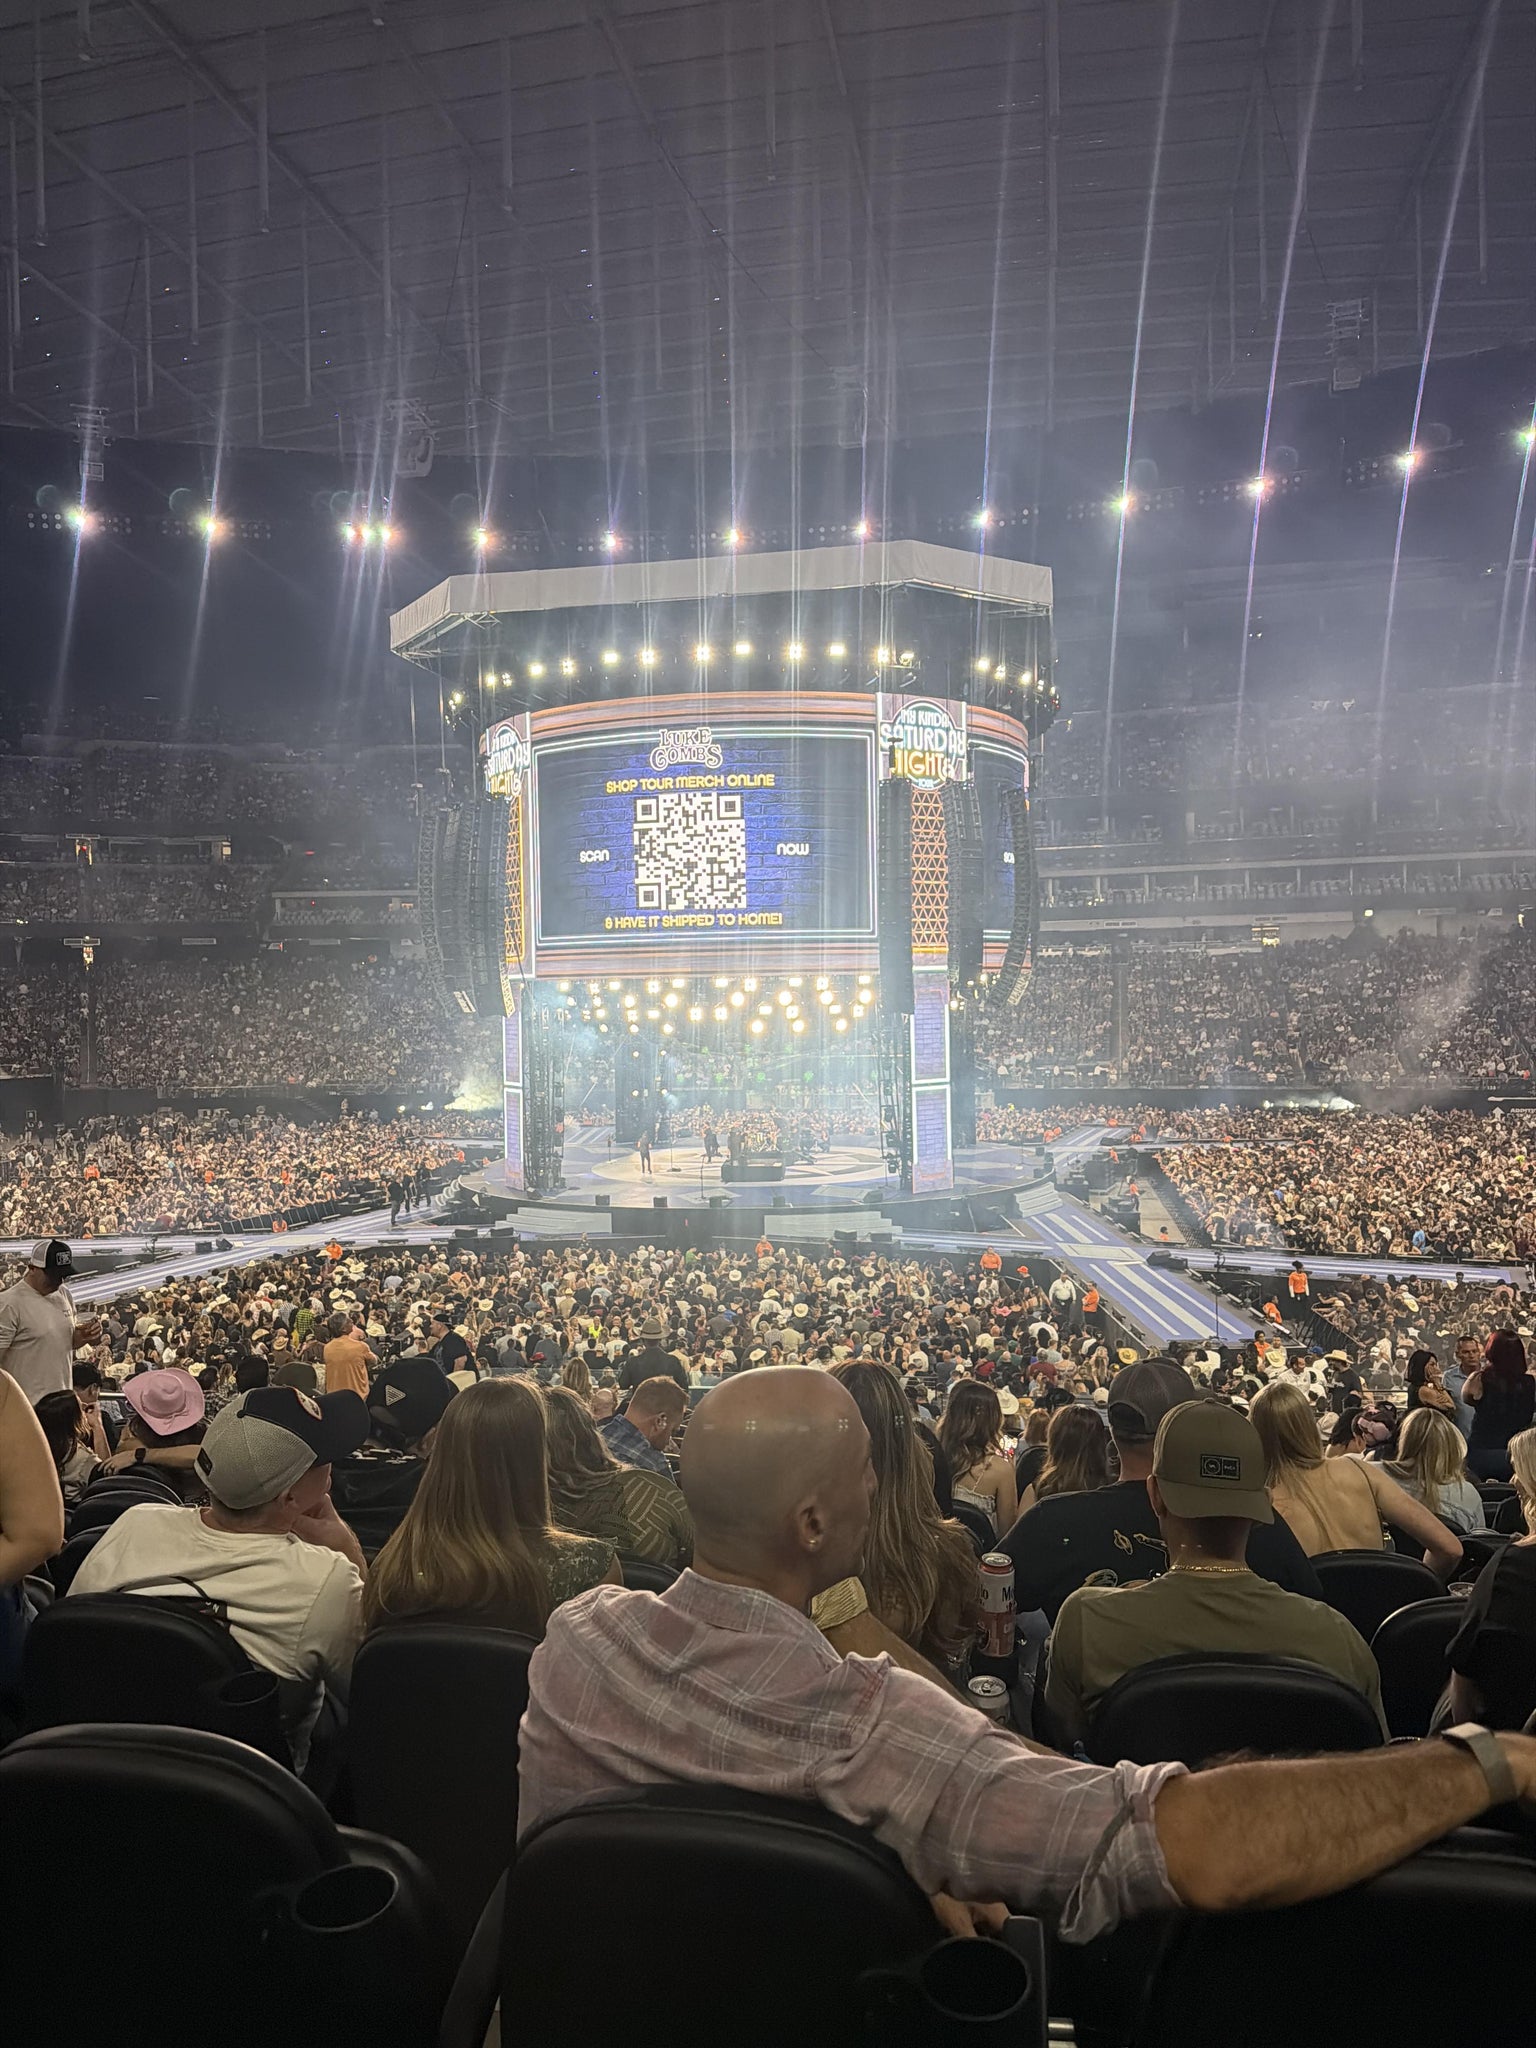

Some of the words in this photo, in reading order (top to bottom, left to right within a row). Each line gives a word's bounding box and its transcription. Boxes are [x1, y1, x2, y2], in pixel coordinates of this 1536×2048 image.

[660, 727, 712, 748] LUKE
[880, 723, 965, 757] SATURDAY
[650, 745, 723, 771] COMBS
[606, 778, 638, 794] SHOP
[640, 777, 674, 791] TOUR
[676, 775, 724, 789] MERCH
[727, 774, 776, 787] ONLINE
[579, 849, 610, 863] SCAN
[776, 843, 810, 856] NOW
[614, 915, 647, 929] HAVE
[648, 914, 660, 928] IT
[662, 913, 714, 928] SHIPPED
[716, 913, 736, 926] TO
[738, 912, 783, 926] HOME!
